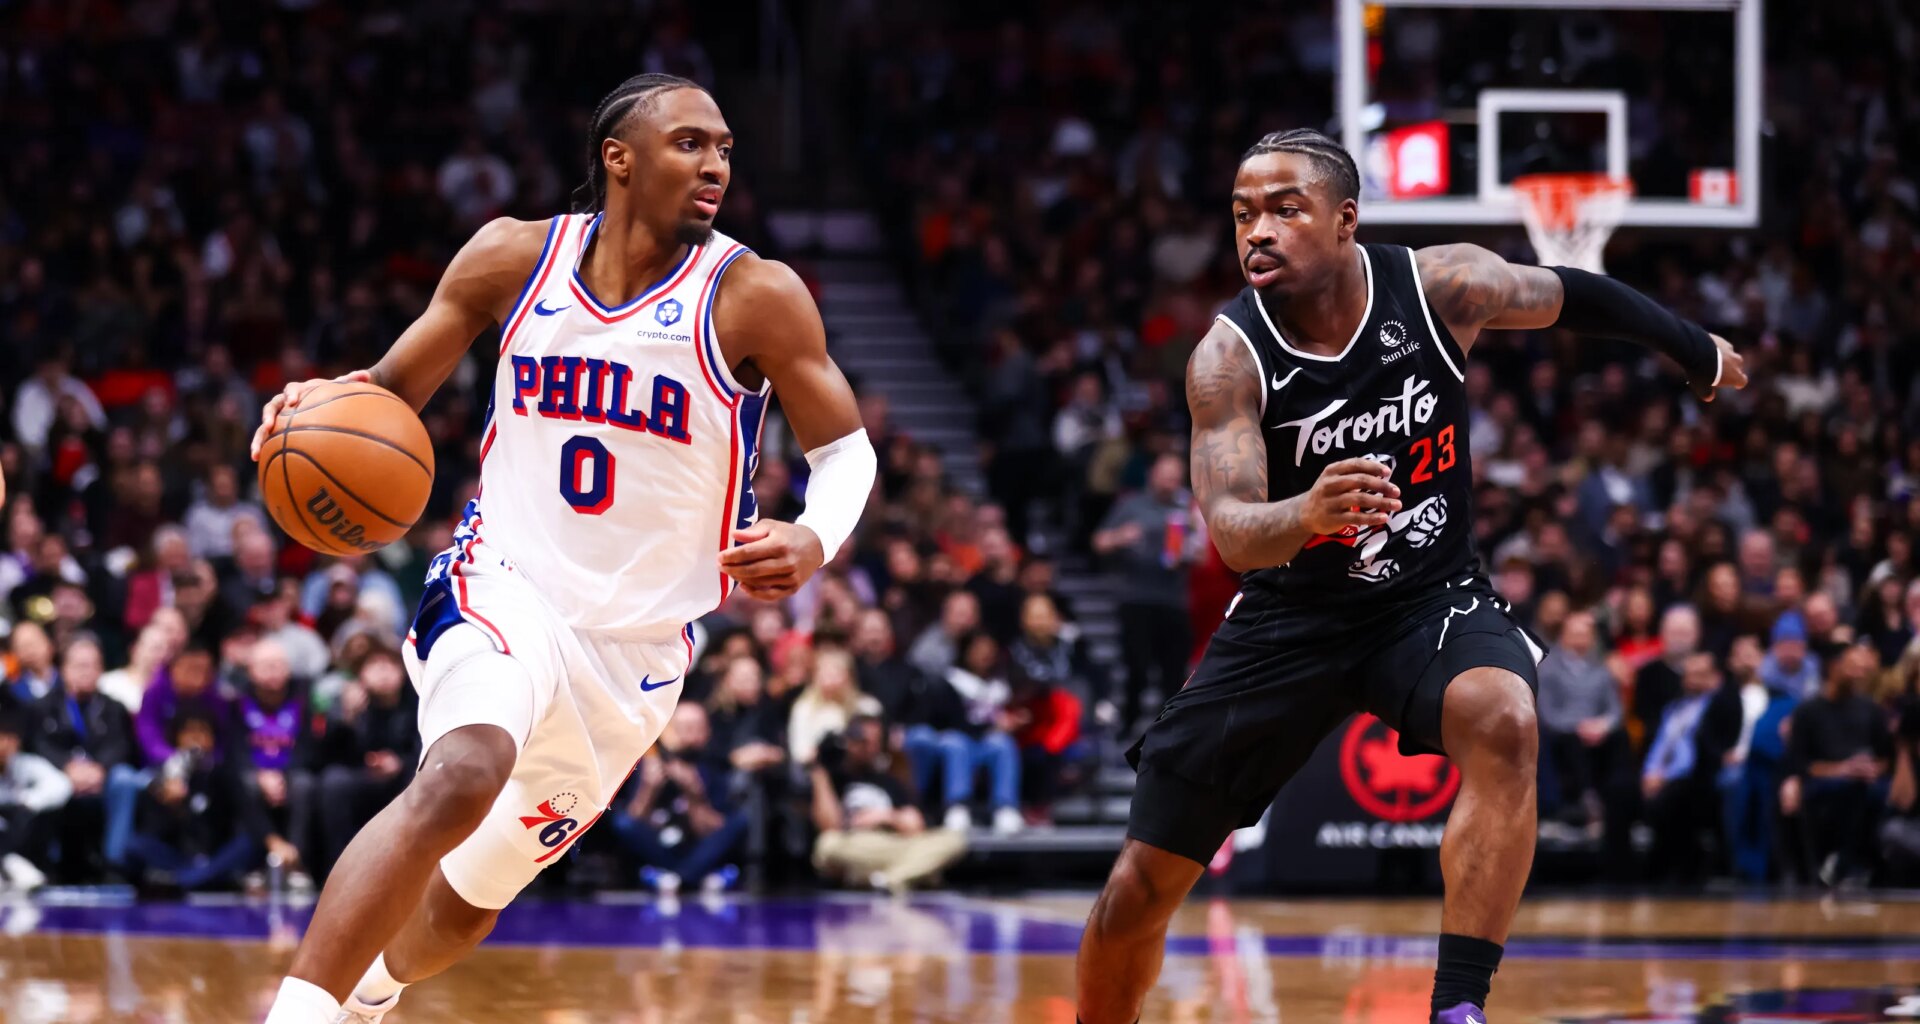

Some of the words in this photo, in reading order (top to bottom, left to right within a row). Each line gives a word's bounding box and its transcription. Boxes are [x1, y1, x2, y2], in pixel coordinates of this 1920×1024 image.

[637, 330, 691, 342] crypto.com
[1381, 351, 1402, 365] Sun
[1401, 340, 1421, 355] Life
[512, 354, 692, 446] PHILA
[1271, 374, 1438, 468] Toronto
[559, 434, 616, 515] 0
[1409, 424, 1457, 485] 23
[1316, 821, 1367, 848] AIR
